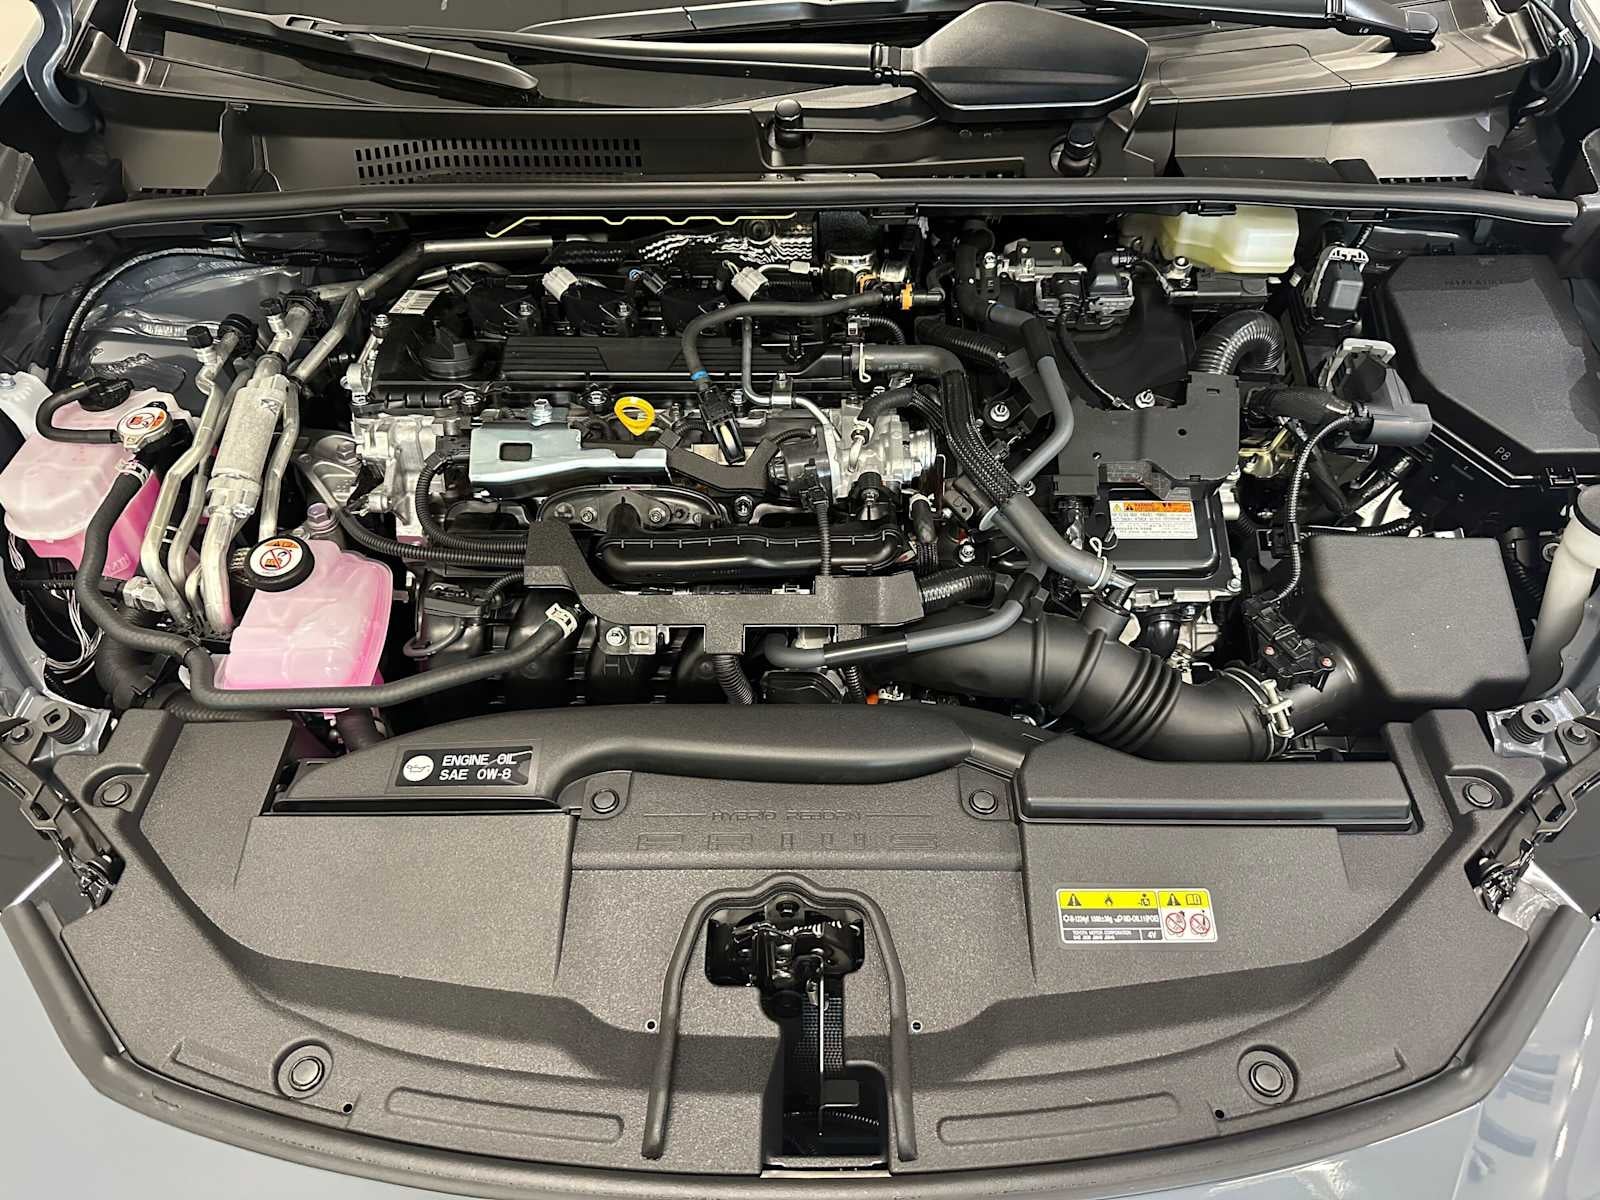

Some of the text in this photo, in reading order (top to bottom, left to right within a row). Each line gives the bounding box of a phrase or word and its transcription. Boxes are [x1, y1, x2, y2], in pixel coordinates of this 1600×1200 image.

[441, 752, 518, 767] ENGINE OIL
[439, 768, 469, 781] SAE
[711, 808, 863, 822] HYBRID REBORN
